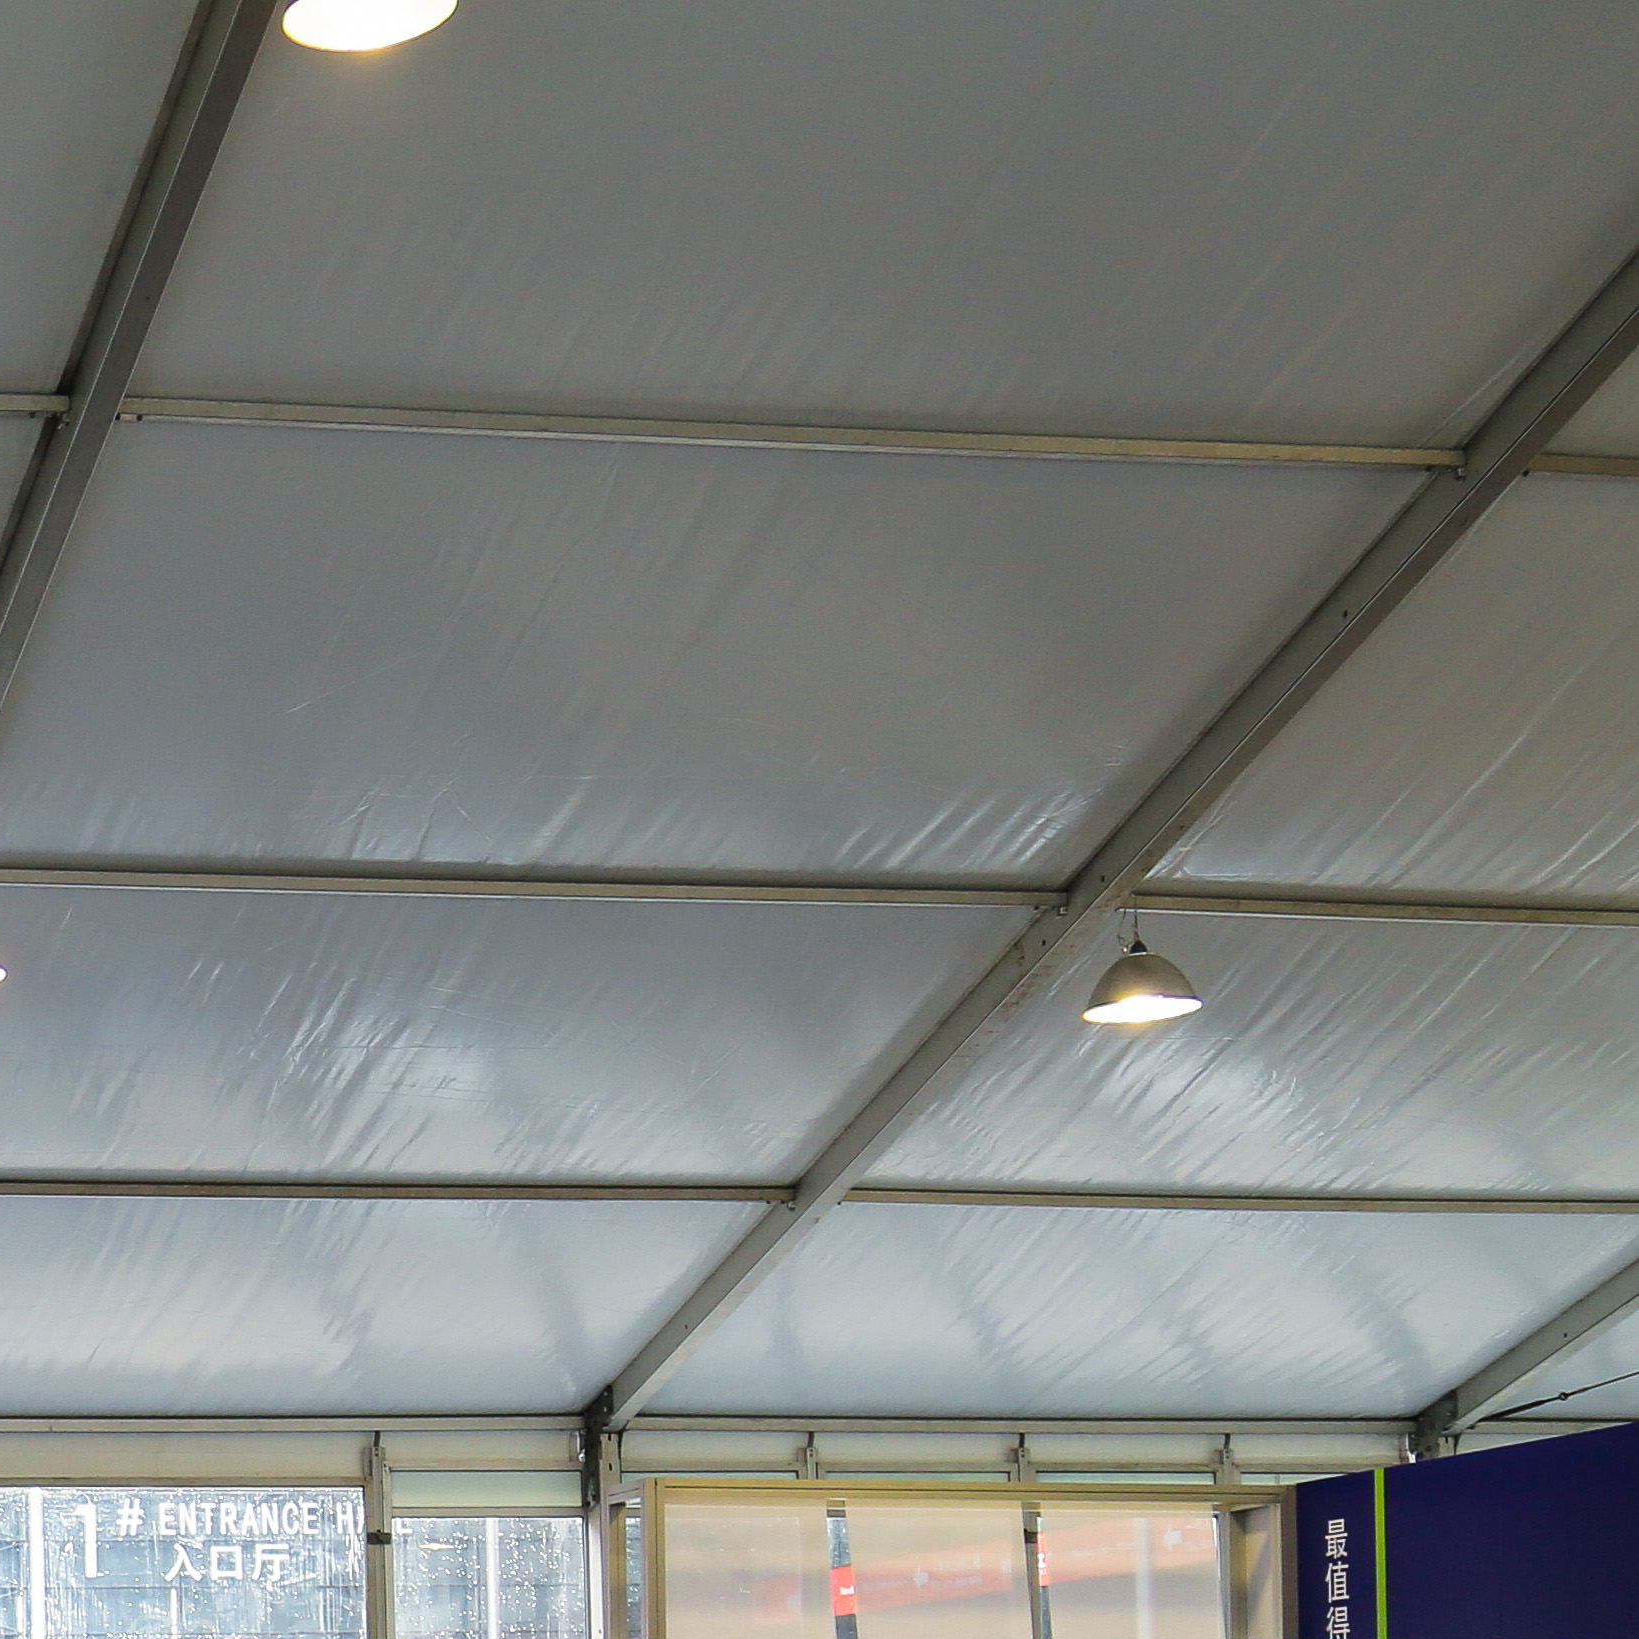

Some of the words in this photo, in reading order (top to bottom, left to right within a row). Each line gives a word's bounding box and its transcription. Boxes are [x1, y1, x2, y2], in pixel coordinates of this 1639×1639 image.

[158, 1502, 320, 1536] ENTRANCE
[165, 1543, 291, 1582] 入口厅
